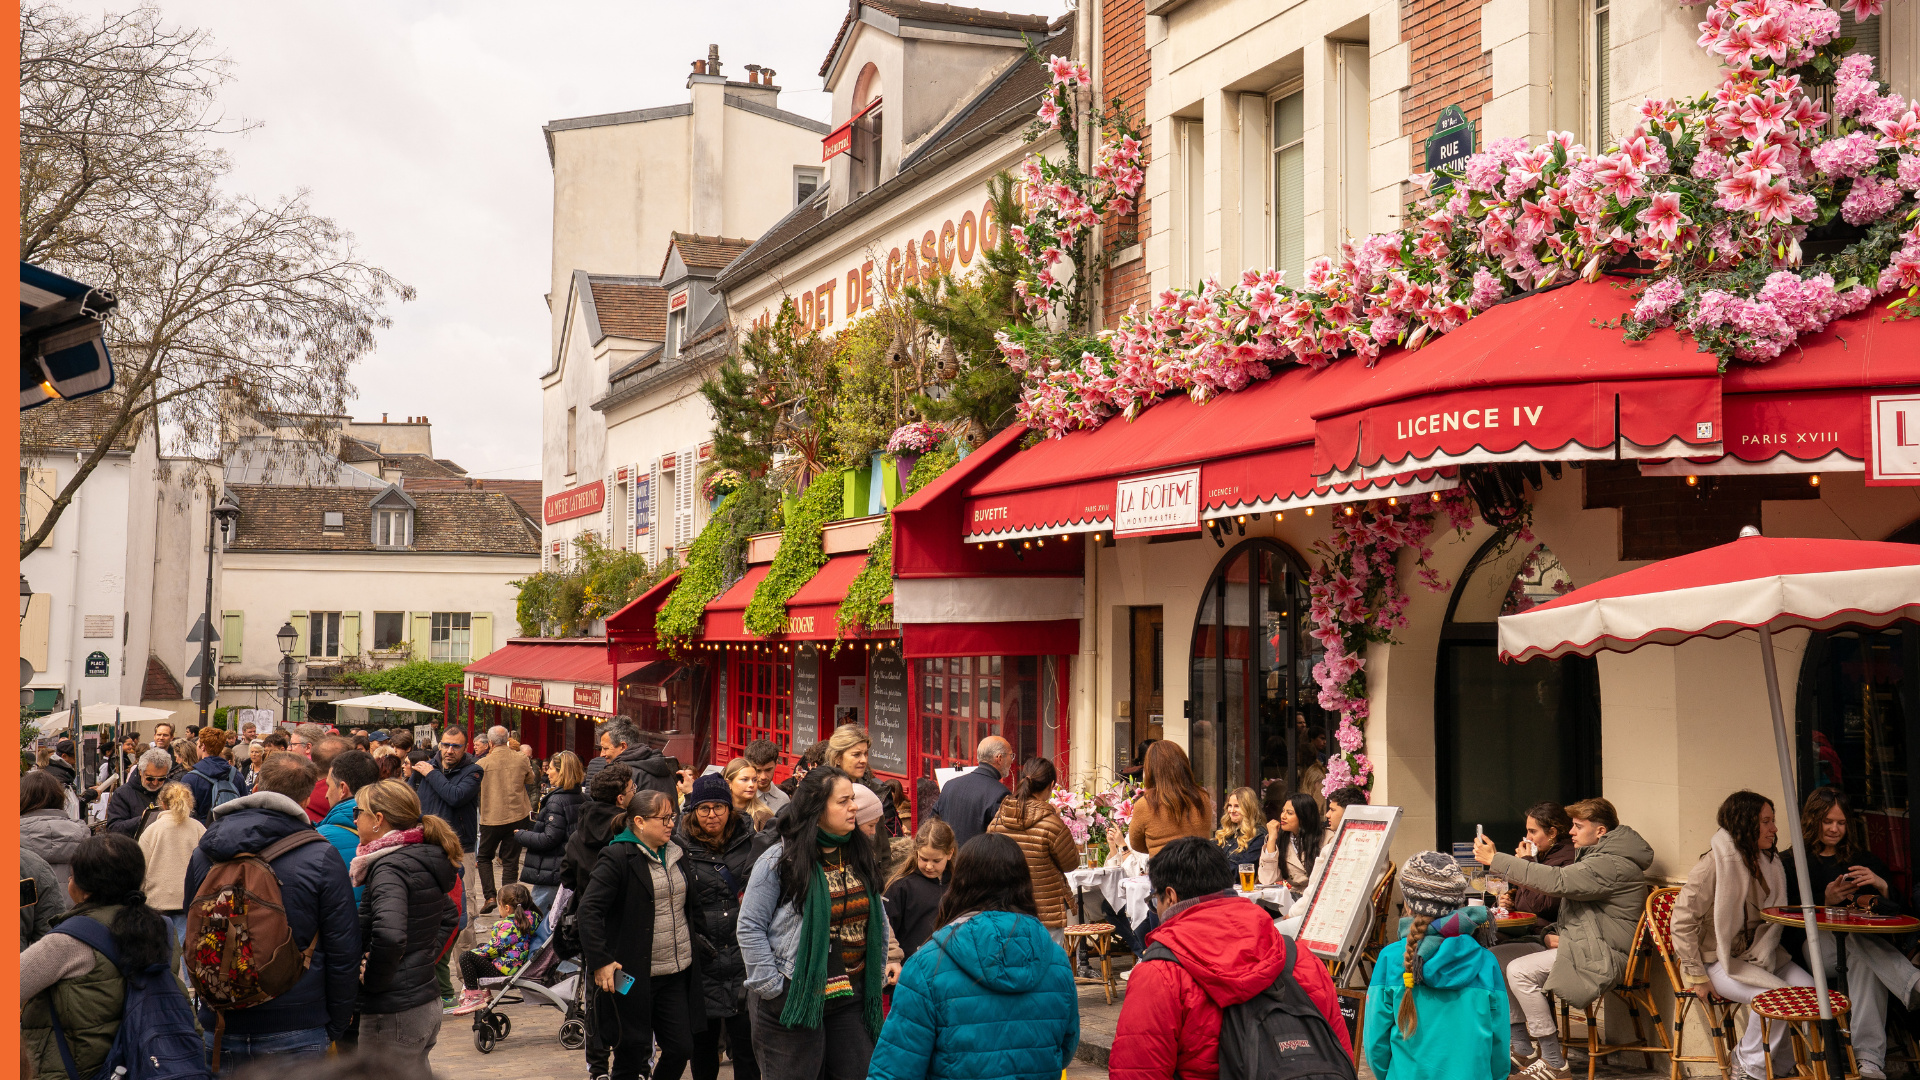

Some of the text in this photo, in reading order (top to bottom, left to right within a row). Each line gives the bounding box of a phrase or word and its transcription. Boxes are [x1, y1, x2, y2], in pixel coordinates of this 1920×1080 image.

[1440, 140, 1459, 160] RUE
[1430, 155, 1470, 173] RVINS
[788, 278, 837, 338] ADET
[846, 260, 874, 319] DE
[885, 184, 1030, 299] GASCOG
[1397, 405, 1544, 440] LICENCE IV
[1742, 431, 1838, 445] PARIS XVIII
[1120, 480, 1193, 513] LA BOHEME
[1208, 486, 1239, 498] LICENCE IV
[548, 502, 554, 518] LA
[569, 487, 599, 512] CATHERINE
[1085, 503, 1110, 513] PARIS XVIII
[974, 506, 1008, 522] BUVETTE
[781, 616, 815, 635] GASCOGNE
